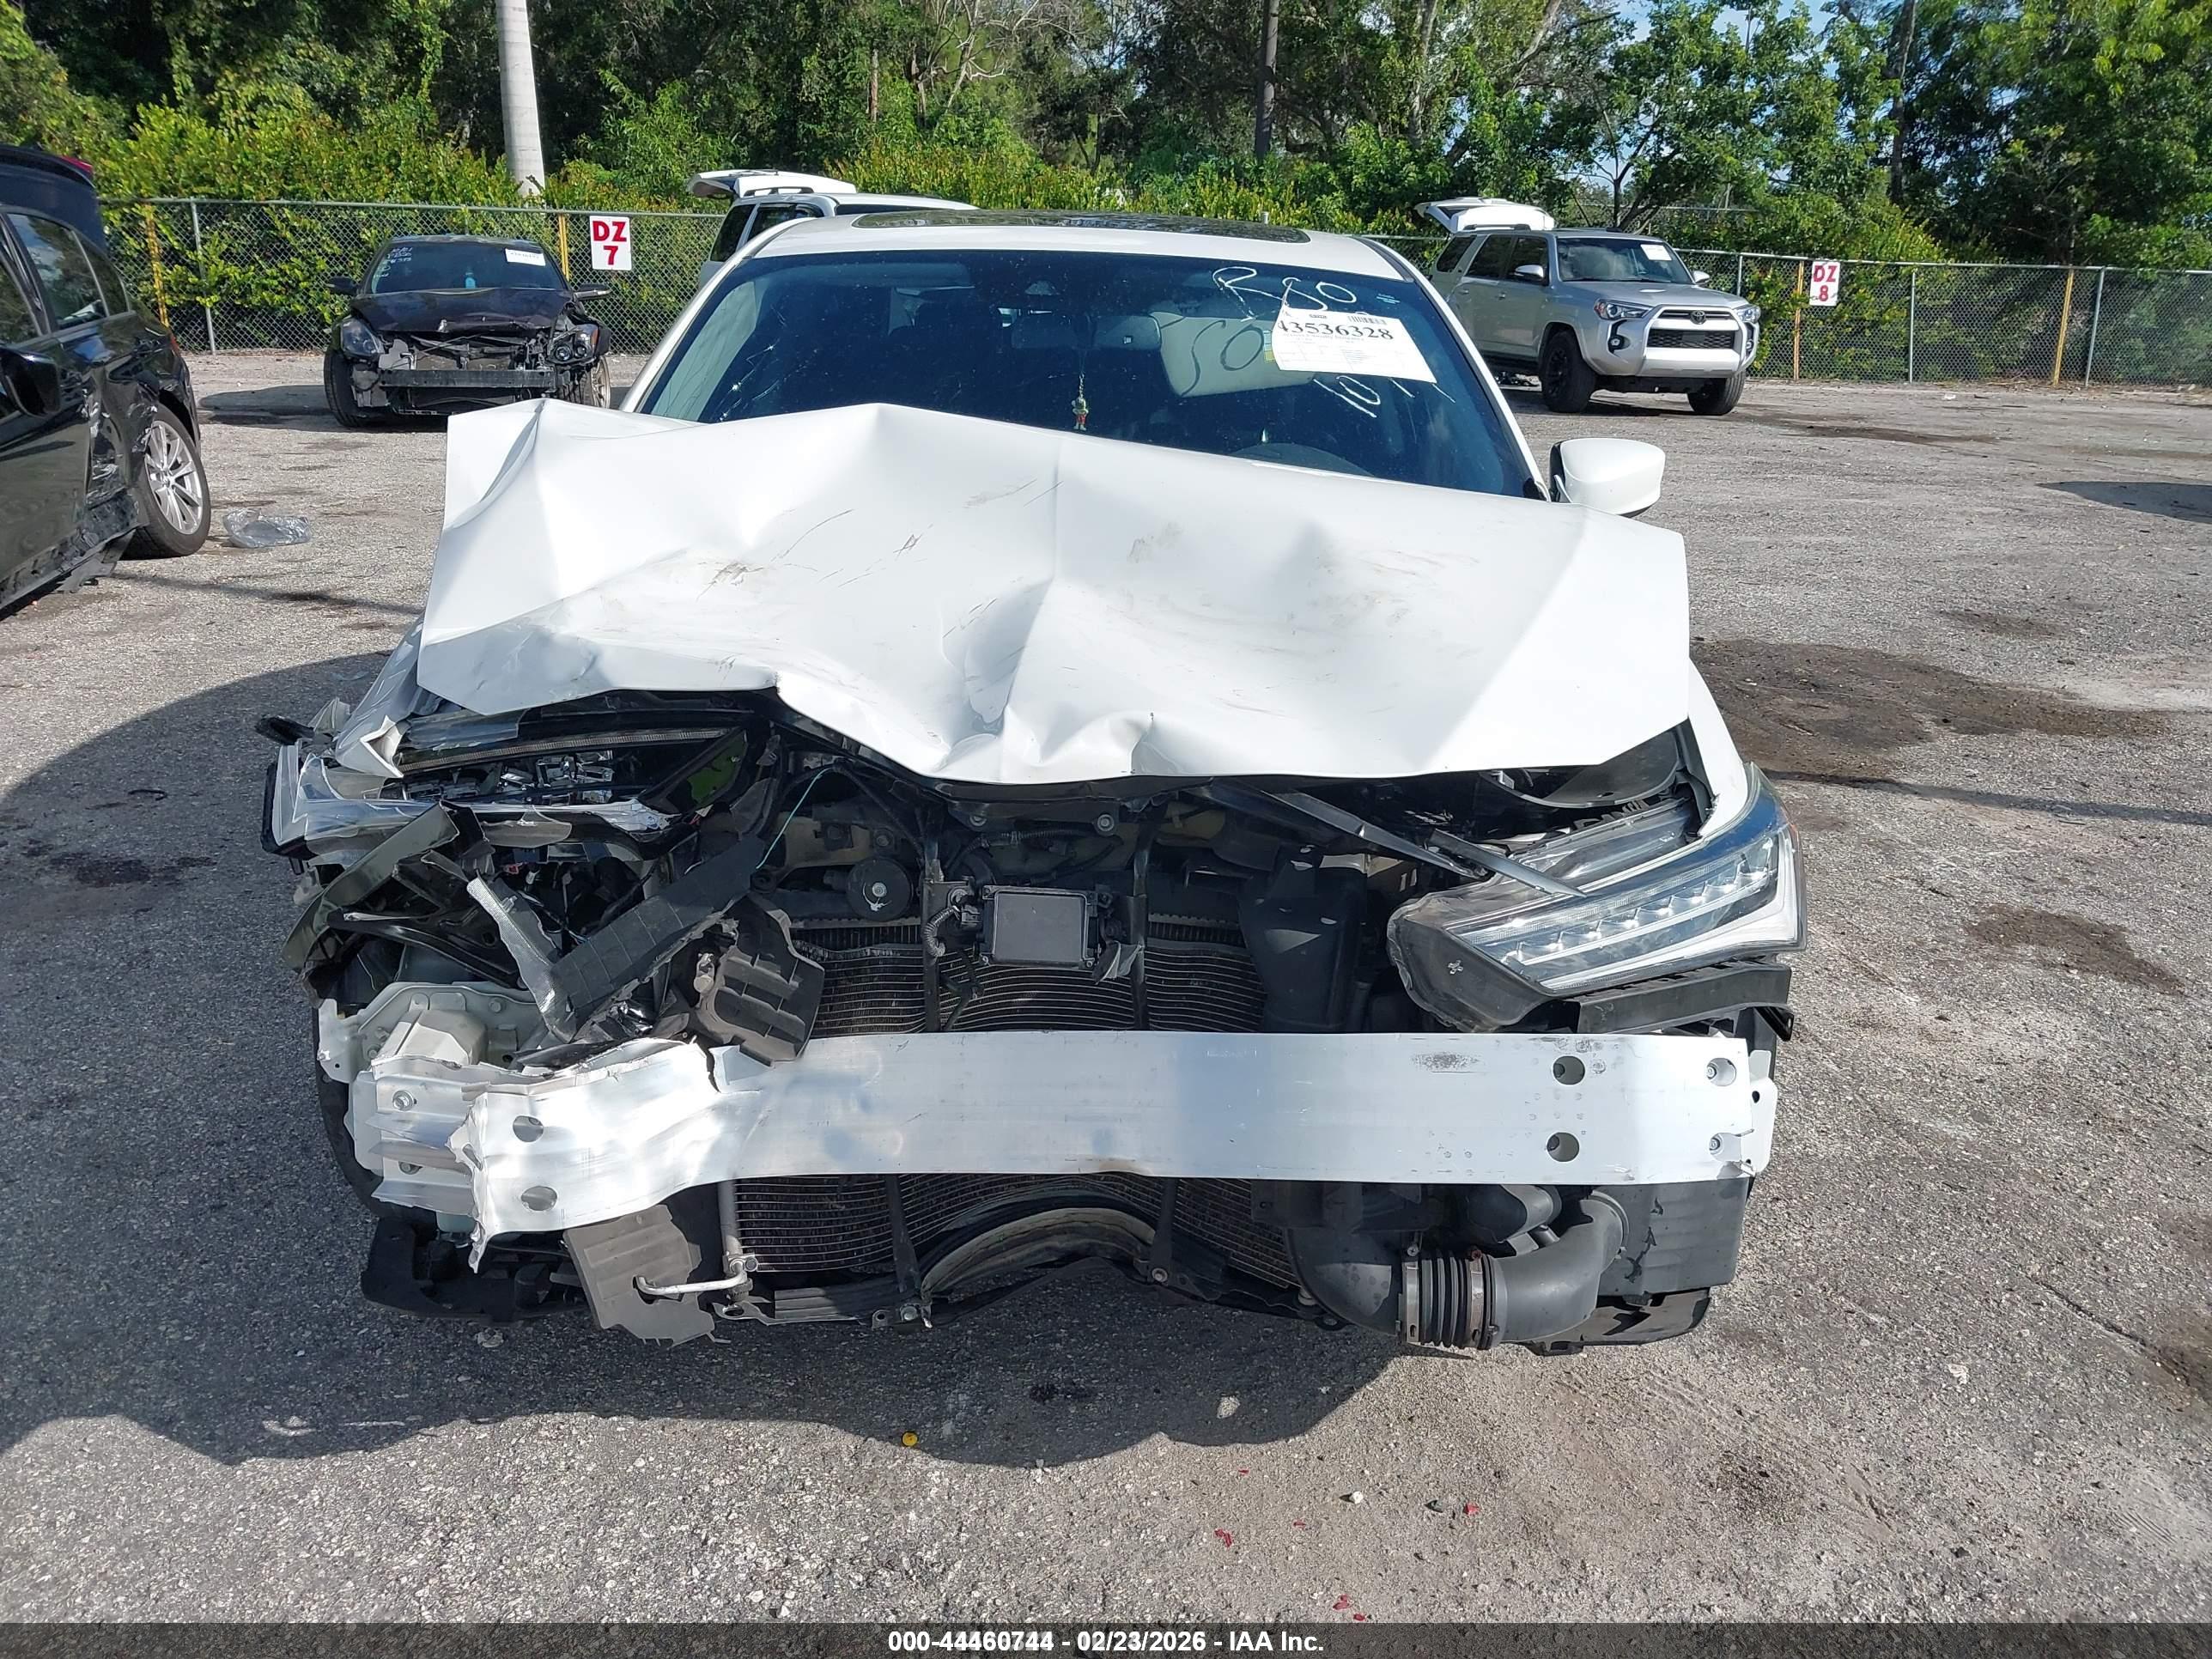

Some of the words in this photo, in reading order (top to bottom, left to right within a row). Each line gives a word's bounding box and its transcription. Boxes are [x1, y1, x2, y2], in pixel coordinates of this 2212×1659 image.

[592, 221, 627, 242] DZ
[604, 246, 619, 265] 7
[1813, 265, 1838, 283] DZ
[1819, 285, 1829, 301] 8
